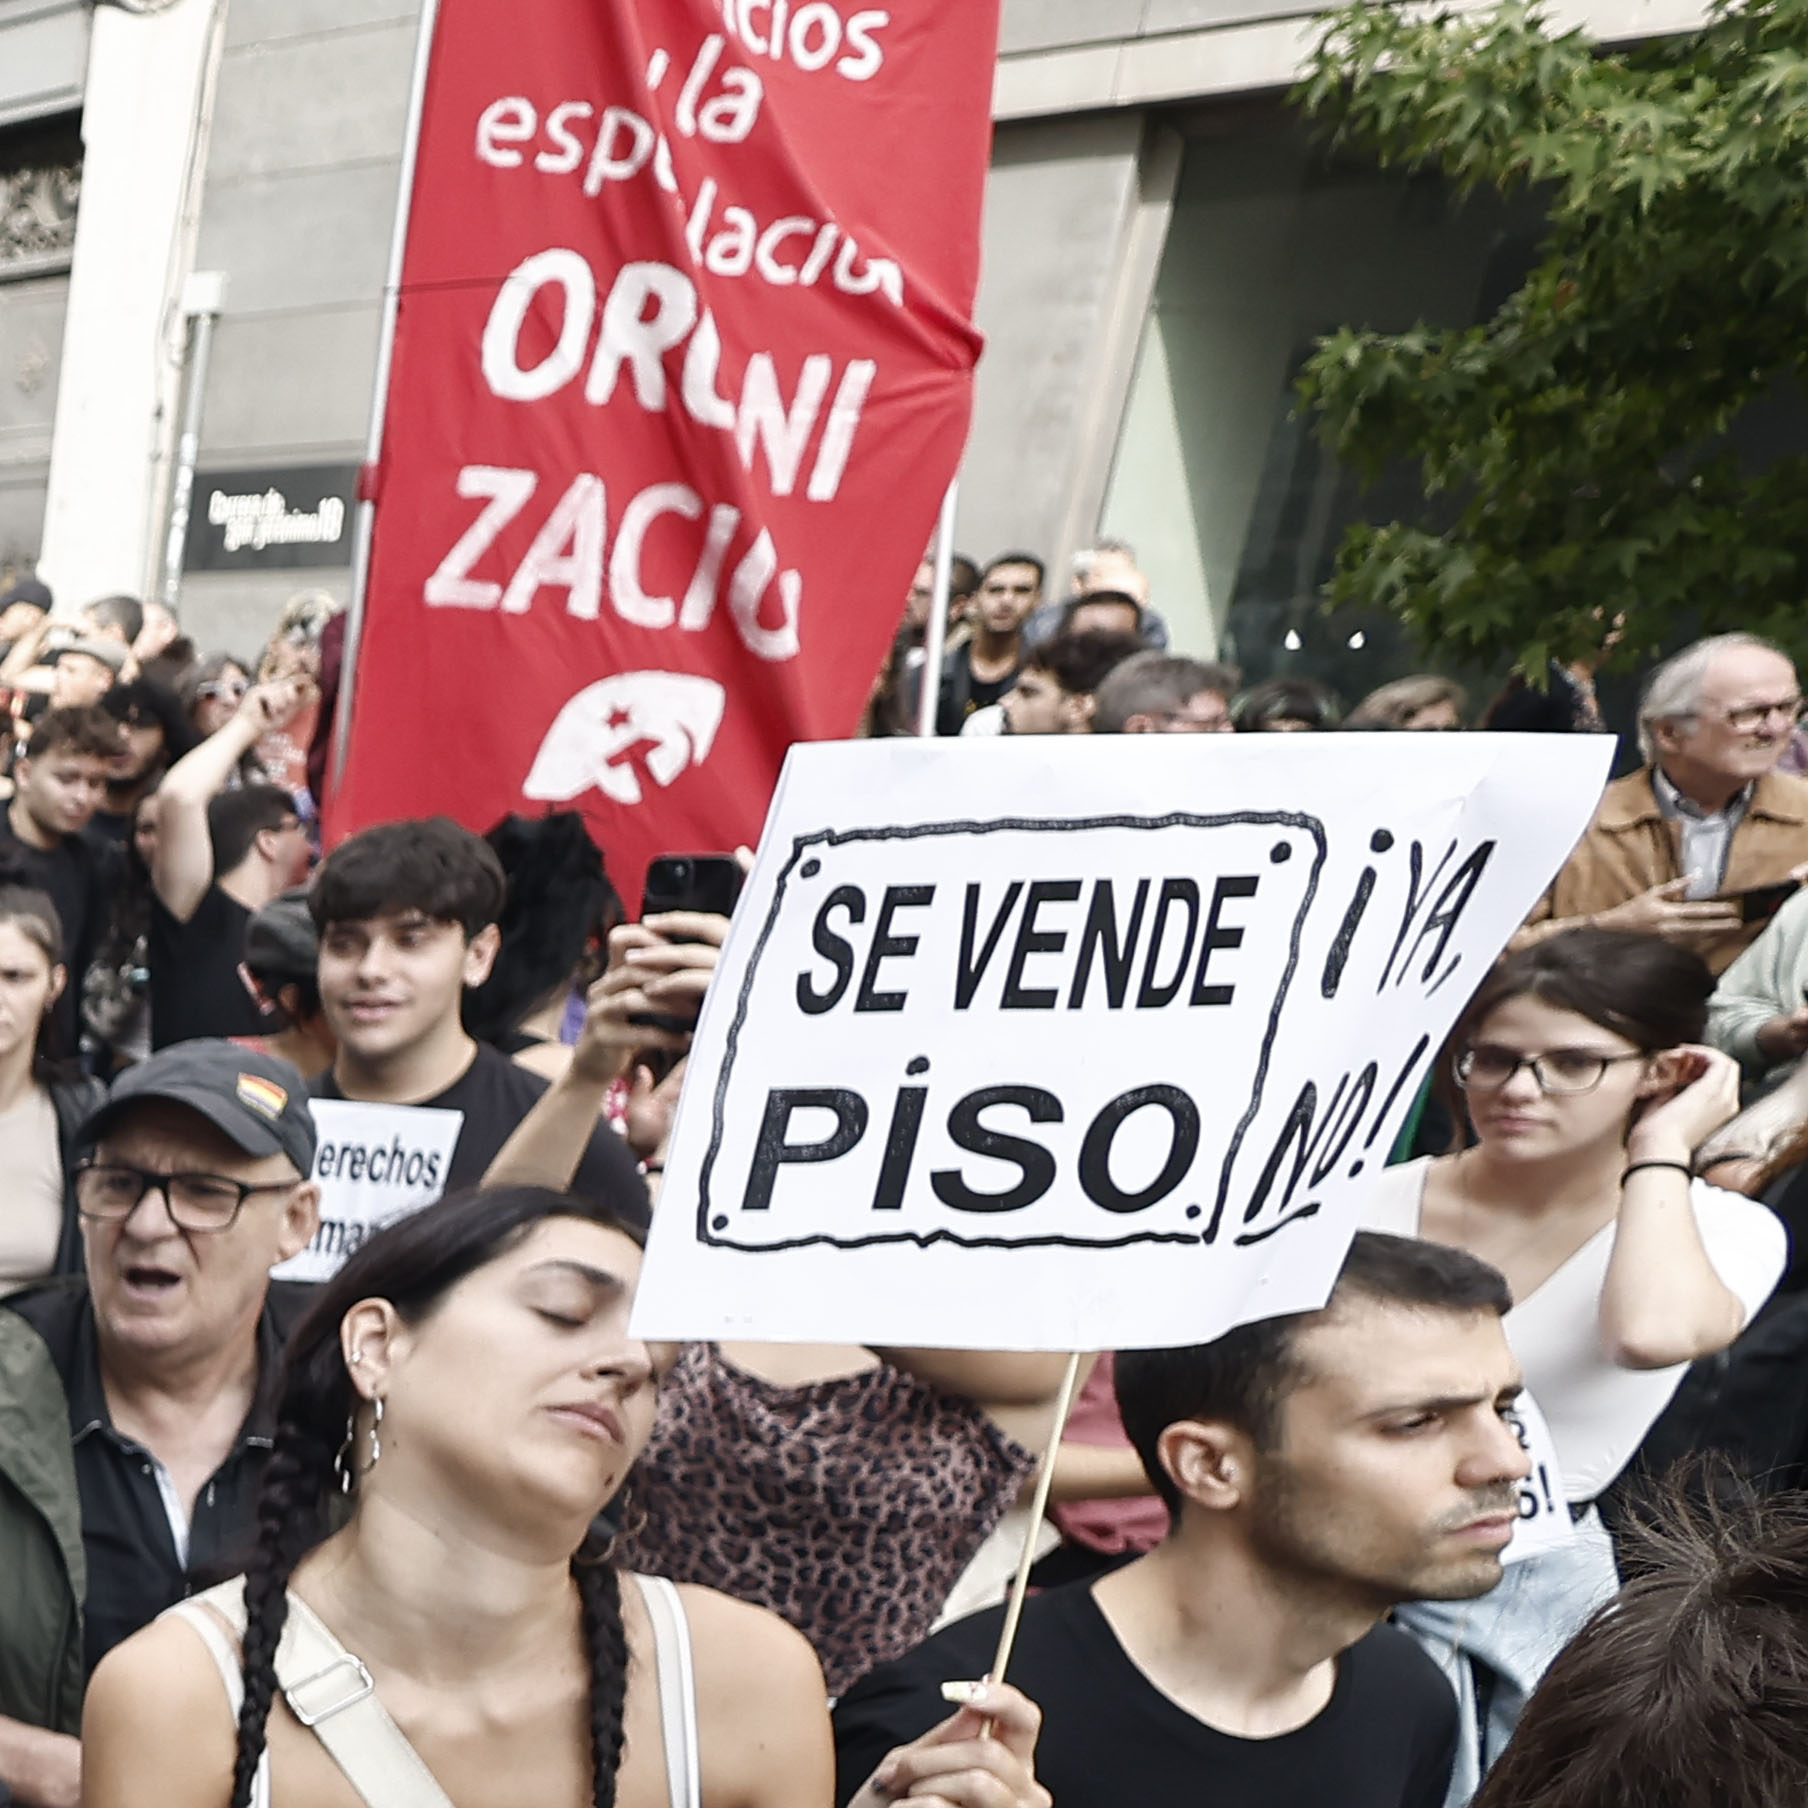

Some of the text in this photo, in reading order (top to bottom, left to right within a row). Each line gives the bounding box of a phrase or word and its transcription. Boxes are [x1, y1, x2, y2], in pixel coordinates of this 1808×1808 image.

[722, 0, 889, 80] cios
[795, 884, 937, 1016] SE
[953, 874, 1261, 1012] VENDE
[317, 1130, 442, 1192] erechos
[1242, 1033, 1431, 1224] NO!
